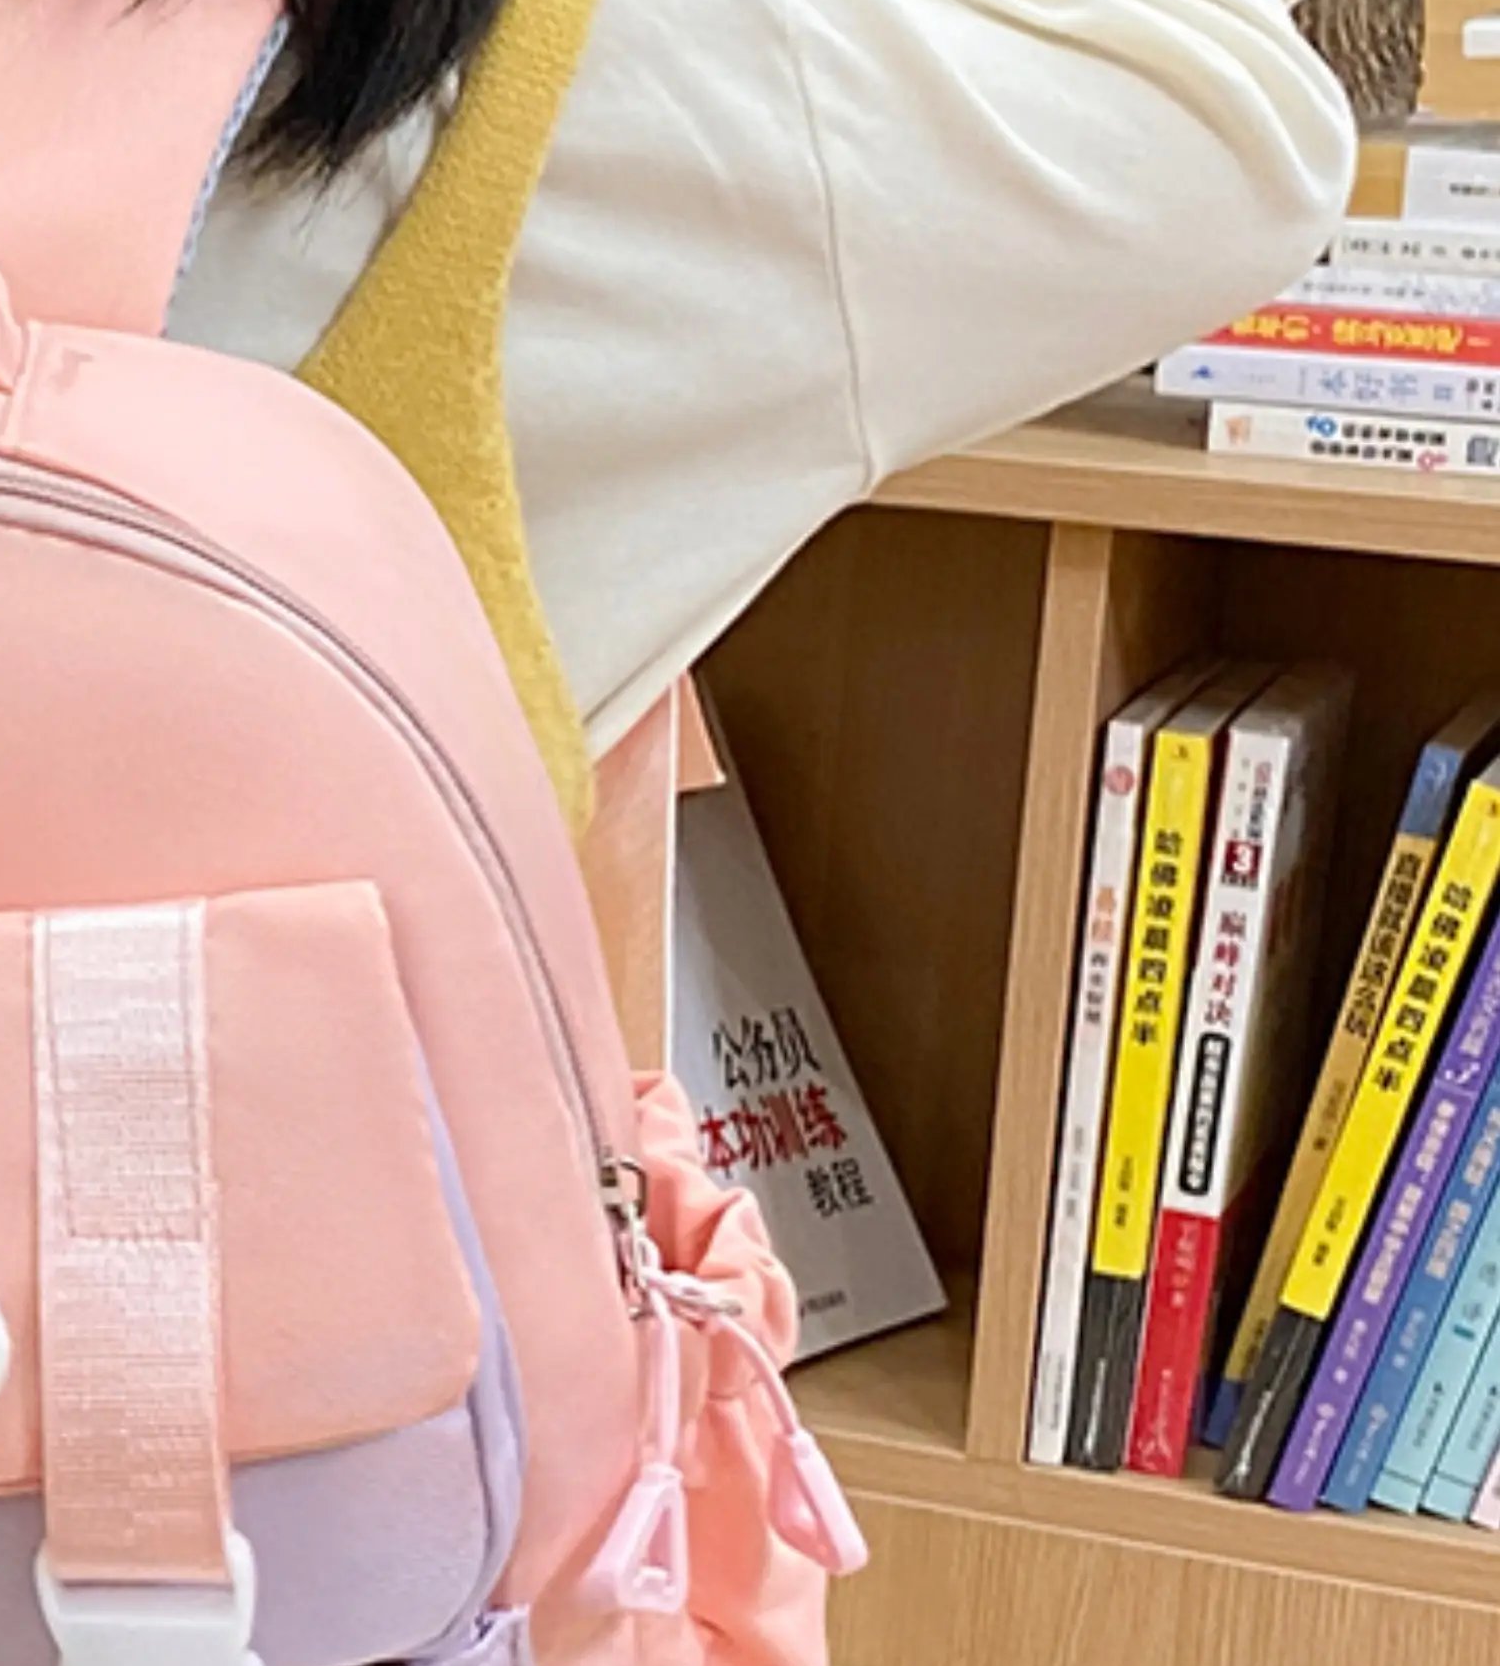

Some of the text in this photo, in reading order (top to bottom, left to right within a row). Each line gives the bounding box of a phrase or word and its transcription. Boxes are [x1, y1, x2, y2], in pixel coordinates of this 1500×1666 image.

[1130, 829, 1183, 1047] 哈佛凌晨四点半
[1373, 880, 1473, 1093] 哈佛凌晨四点半
[711, 1005, 822, 1089] 公务员
[805, 1156, 875, 1218] 教程
